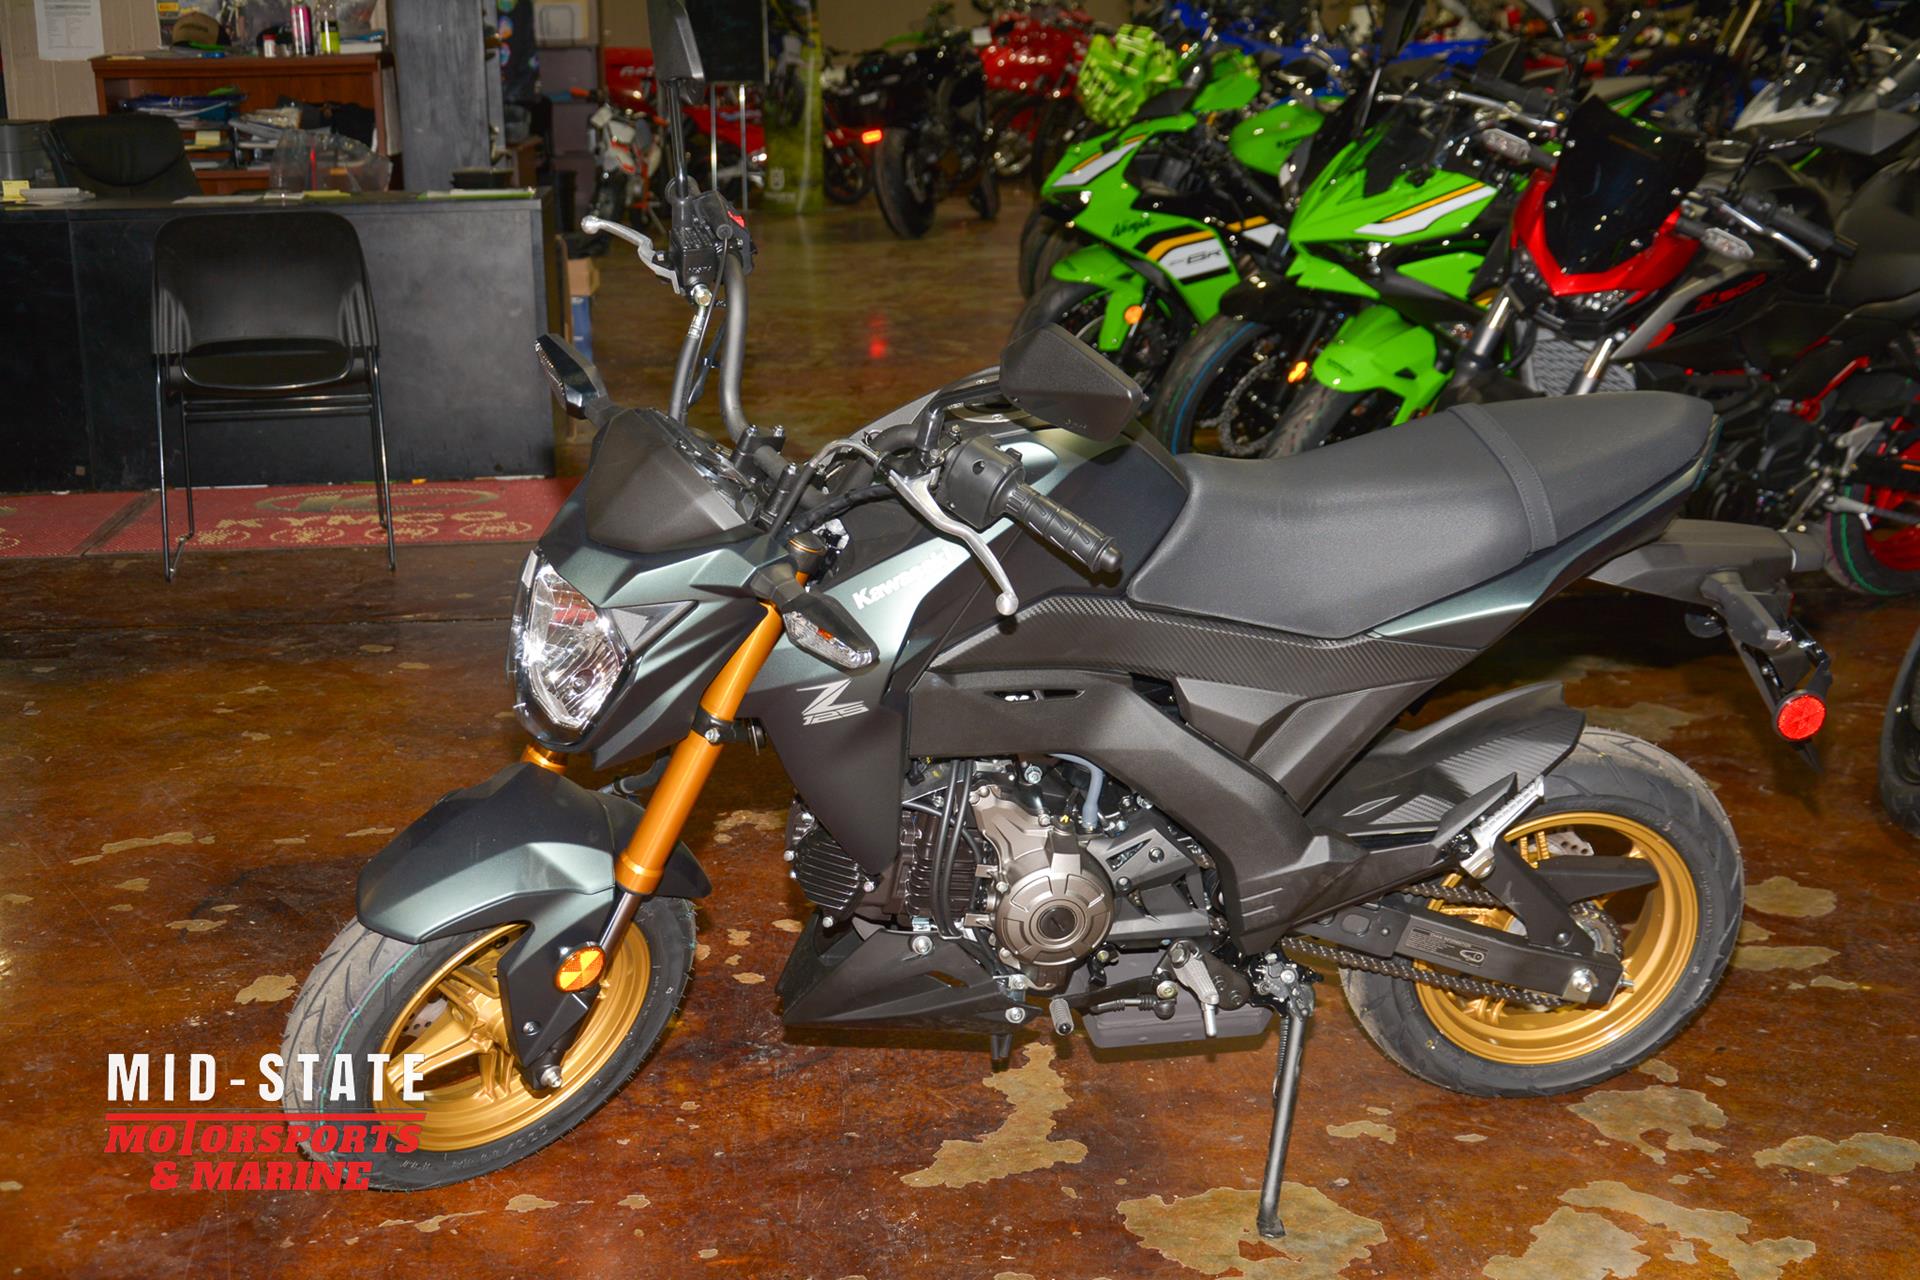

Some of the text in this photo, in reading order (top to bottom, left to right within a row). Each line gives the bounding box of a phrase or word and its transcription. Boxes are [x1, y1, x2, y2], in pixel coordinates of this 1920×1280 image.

[216, 511, 508, 528] KYMCO
[796, 677, 865, 717] Z
[802, 703, 870, 726] 125
